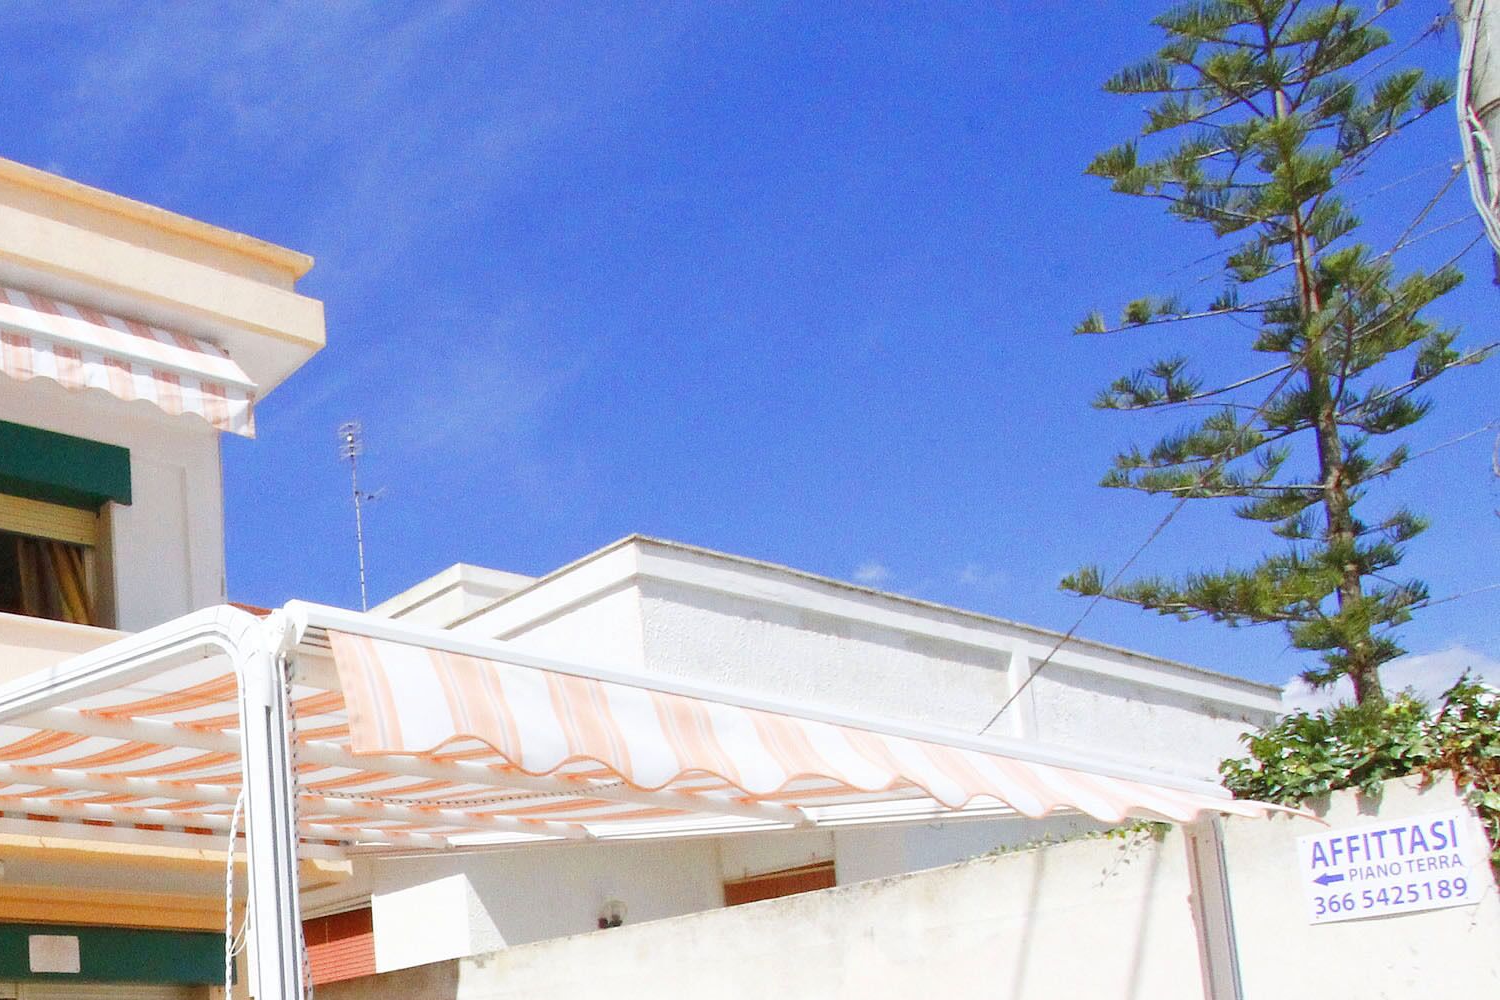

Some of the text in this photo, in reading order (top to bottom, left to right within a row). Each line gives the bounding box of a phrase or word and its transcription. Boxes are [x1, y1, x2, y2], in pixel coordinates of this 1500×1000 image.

[1311, 819, 1458, 869] AFFITTASI
[1348, 853, 1463, 881] PIANO TERRA
[1314, 877, 1468, 915] 366 5425189
